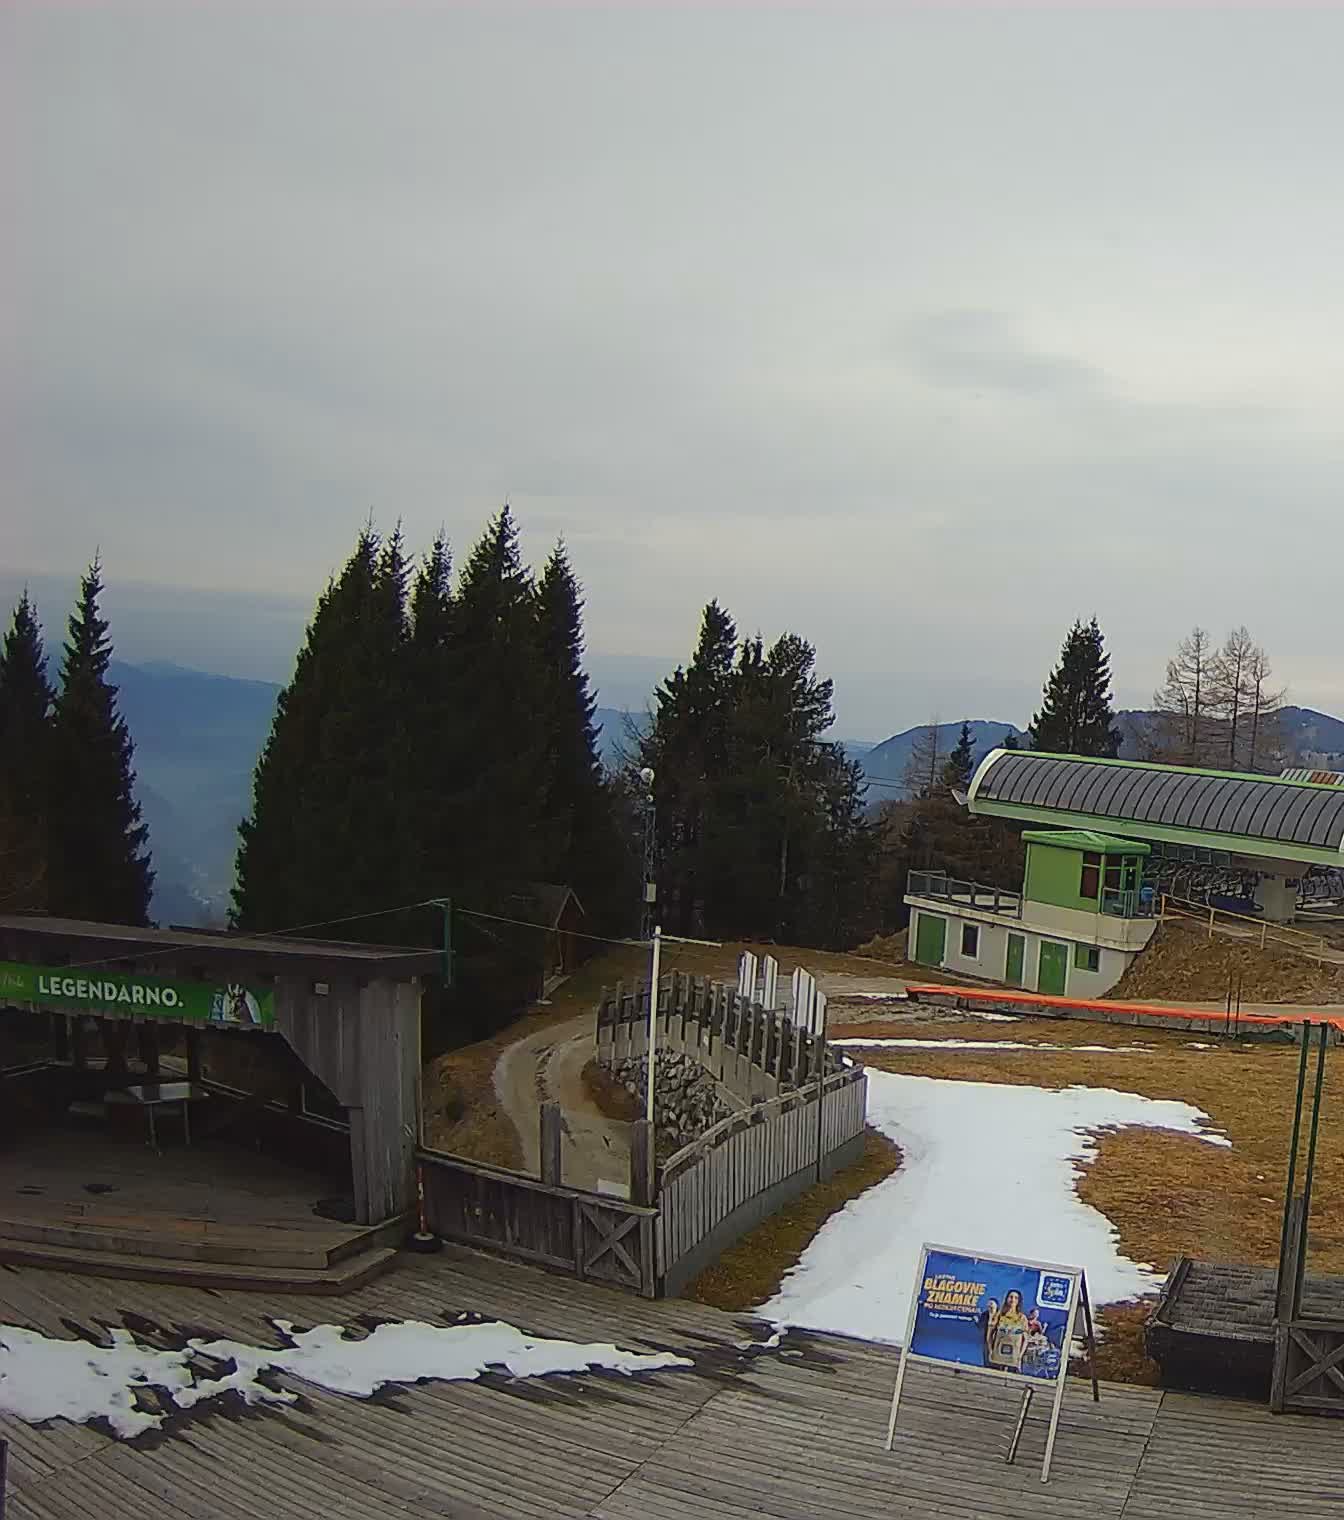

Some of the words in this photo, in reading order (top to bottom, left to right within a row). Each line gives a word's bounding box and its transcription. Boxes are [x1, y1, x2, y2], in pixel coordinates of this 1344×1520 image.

[38, 975, 184, 1008] LEGENDARNO.
[924, 1277, 987, 1296] BLAGOVNE
[927, 1290, 980, 1306] ZNAMKE
